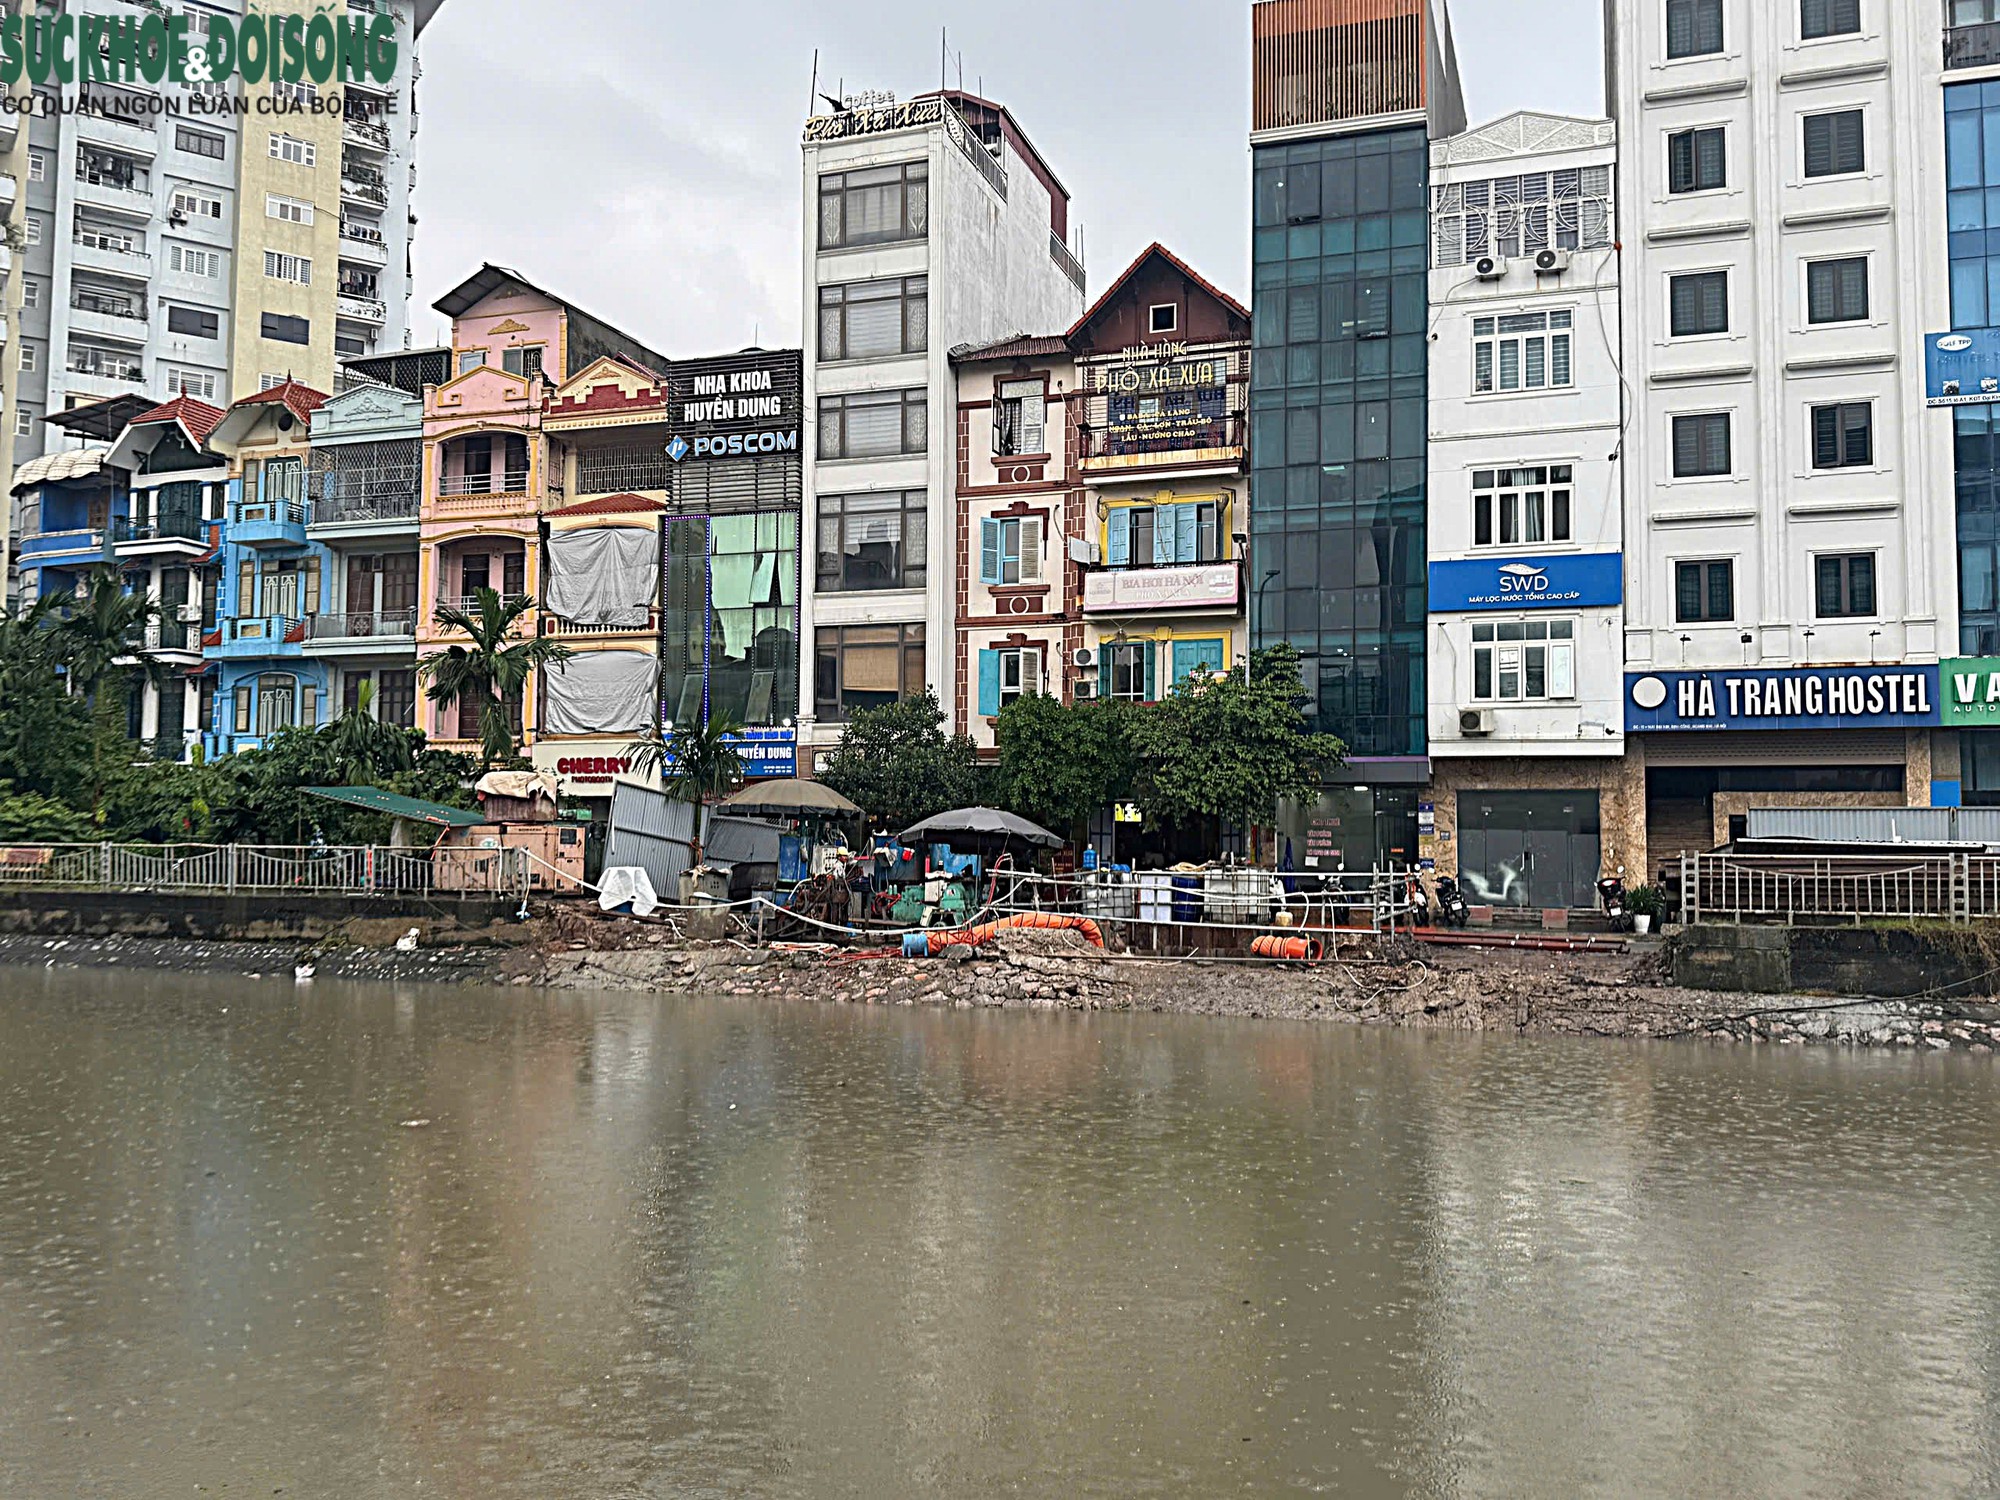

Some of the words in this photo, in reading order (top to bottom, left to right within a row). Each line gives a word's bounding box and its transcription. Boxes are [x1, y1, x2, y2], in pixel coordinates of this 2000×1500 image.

[1122, 340, 1149, 361] NHÀ
[1154, 338, 1187, 358] HÀNG
[694, 374, 727, 395] NHA
[730, 371, 772, 392] KHOA
[1095, 361, 1141, 394] PHỐ
[1148, 361, 1171, 389] XÁ
[1179, 362, 1213, 386] XƯA
[684, 394, 734, 422] HUYỀN
[738, 396, 781, 418] DUNG
[694, 430, 797, 456] POSCOM
[1499, 576, 1549, 592] SWD
[1678, 673, 1715, 717] HÀ
[1726, 675, 1823, 716] TRANG
[1829, 673, 1931, 715] HOSTEL
[1953, 704, 1996, 713] AUTO
[768, 747, 792, 759] DUNG
[557, 757, 632, 774] CHERRY
